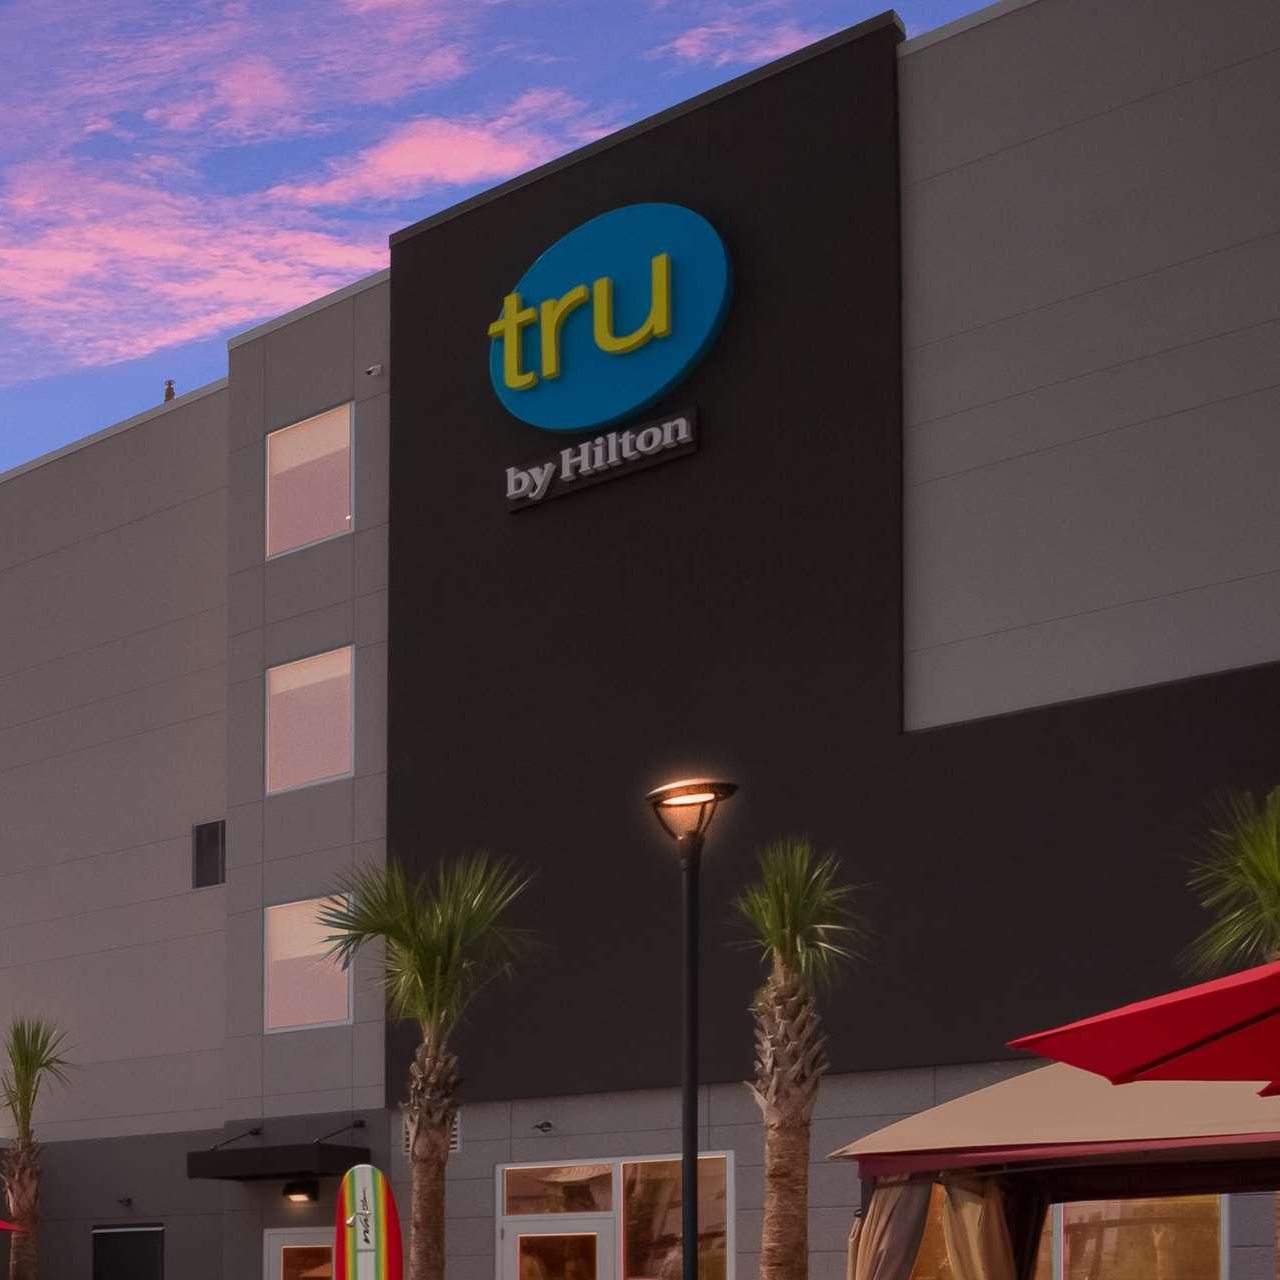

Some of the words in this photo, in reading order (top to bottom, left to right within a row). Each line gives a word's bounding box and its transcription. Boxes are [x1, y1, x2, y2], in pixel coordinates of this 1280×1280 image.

[487, 252, 672, 392] tru
[505, 460, 557, 502] by
[559, 415, 693, 482] Hilton
